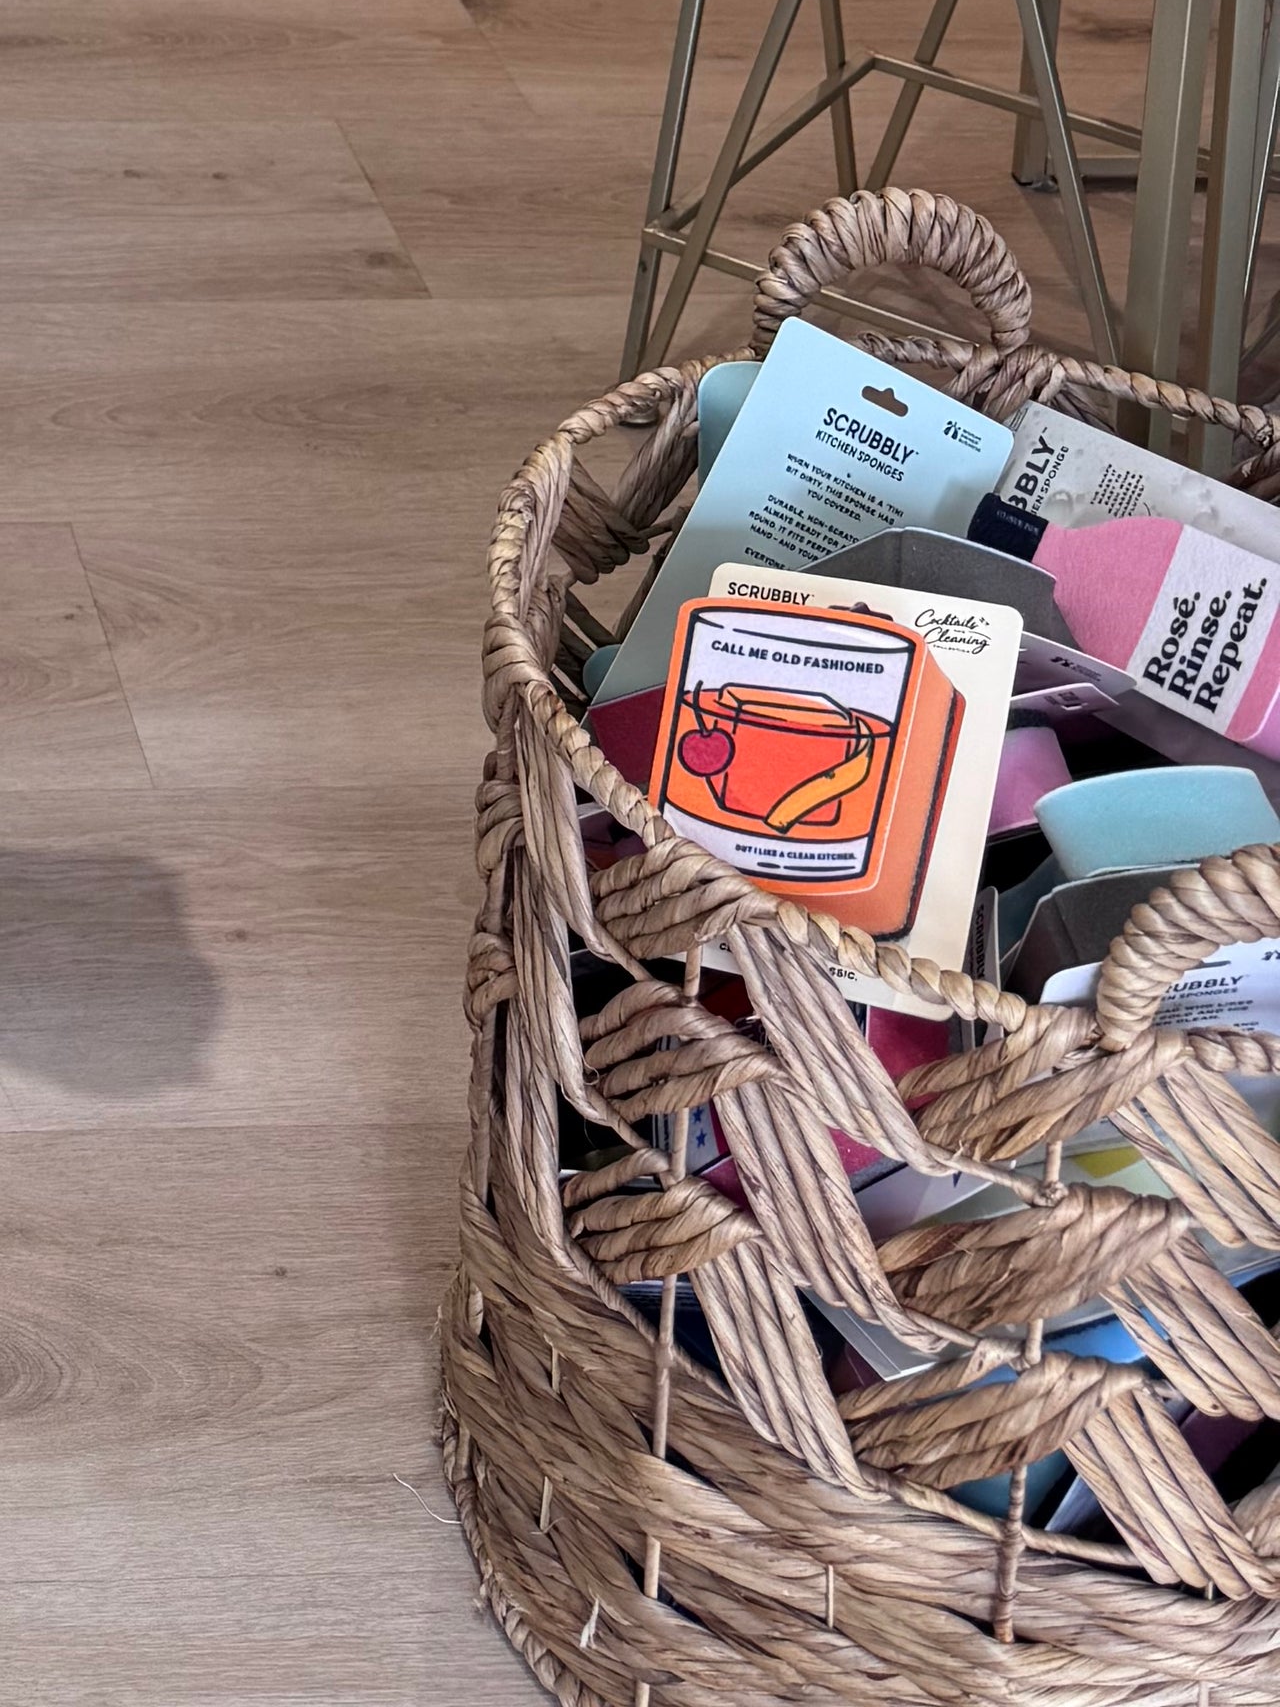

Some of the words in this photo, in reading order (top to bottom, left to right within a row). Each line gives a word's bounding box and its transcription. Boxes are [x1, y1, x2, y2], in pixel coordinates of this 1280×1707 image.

[823, 407, 915, 465] SCRUBBLY
[815, 429, 858, 458] KITCHEN
[856, 450, 905, 482] SPONGES
[1041, 446, 1069, 494] SPONGE
[785, 465, 799, 476] BIT
[826, 485, 842, 499] THIS
[843, 494, 876, 517] SPONGE
[808, 488, 823, 501] YOU
[811, 465, 832, 480] YOUR
[833, 475, 867, 498] KITCHEN
[763, 505, 794, 525] ALWAYS
[795, 521, 821, 538] READY
[727, 581, 811, 606] SCRUBBLY
[915, 608, 979, 630] Cocktails
[923, 626, 990, 655] Cleaning
[1142, 591, 1201, 688] Rosé.
[1167, 590, 1232, 701] Rinse.
[1193, 577, 1268, 714] Repeat.
[711, 639, 746, 658] CALL
[748, 645, 769, 661] ME
[771, 649, 802, 667] OLD
[803, 654, 885, 675] FASHIONED
[735, 844, 753, 854] BUT
[758, 848, 777, 858] LIKE
[778, 850, 785, 858] A
[788, 851, 816, 861] CLEAN
[1180, 987, 1238, 999] SPONGES
